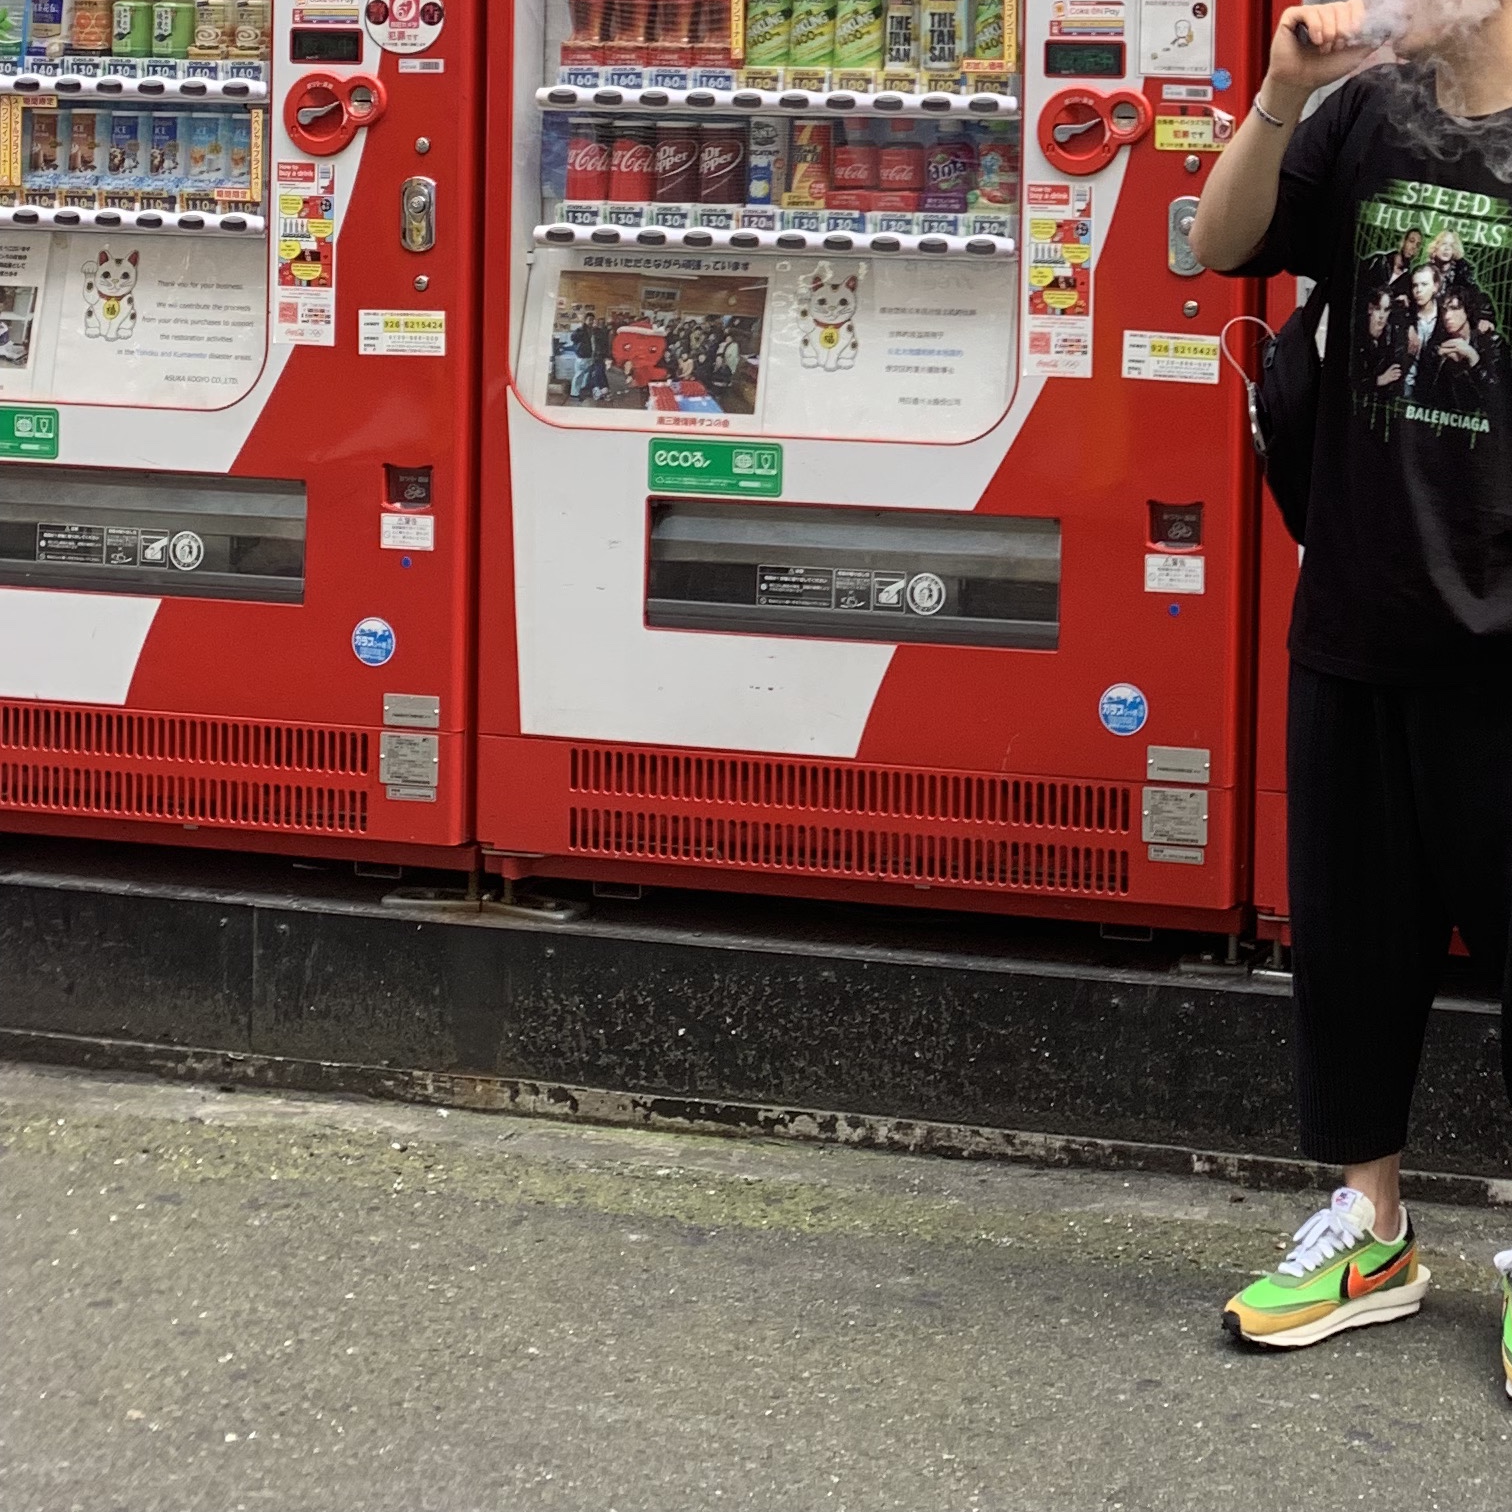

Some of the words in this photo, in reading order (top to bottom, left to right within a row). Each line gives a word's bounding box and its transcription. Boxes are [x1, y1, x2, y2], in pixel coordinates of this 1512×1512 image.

[889, 16, 912, 31] THE
[929, 12, 955, 28] THE
[1402, 180, 1492, 217] SPEED
[1374, 202, 1507, 248] HUNTERS
[1405, 405, 1491, 434] BALENCIAGA
